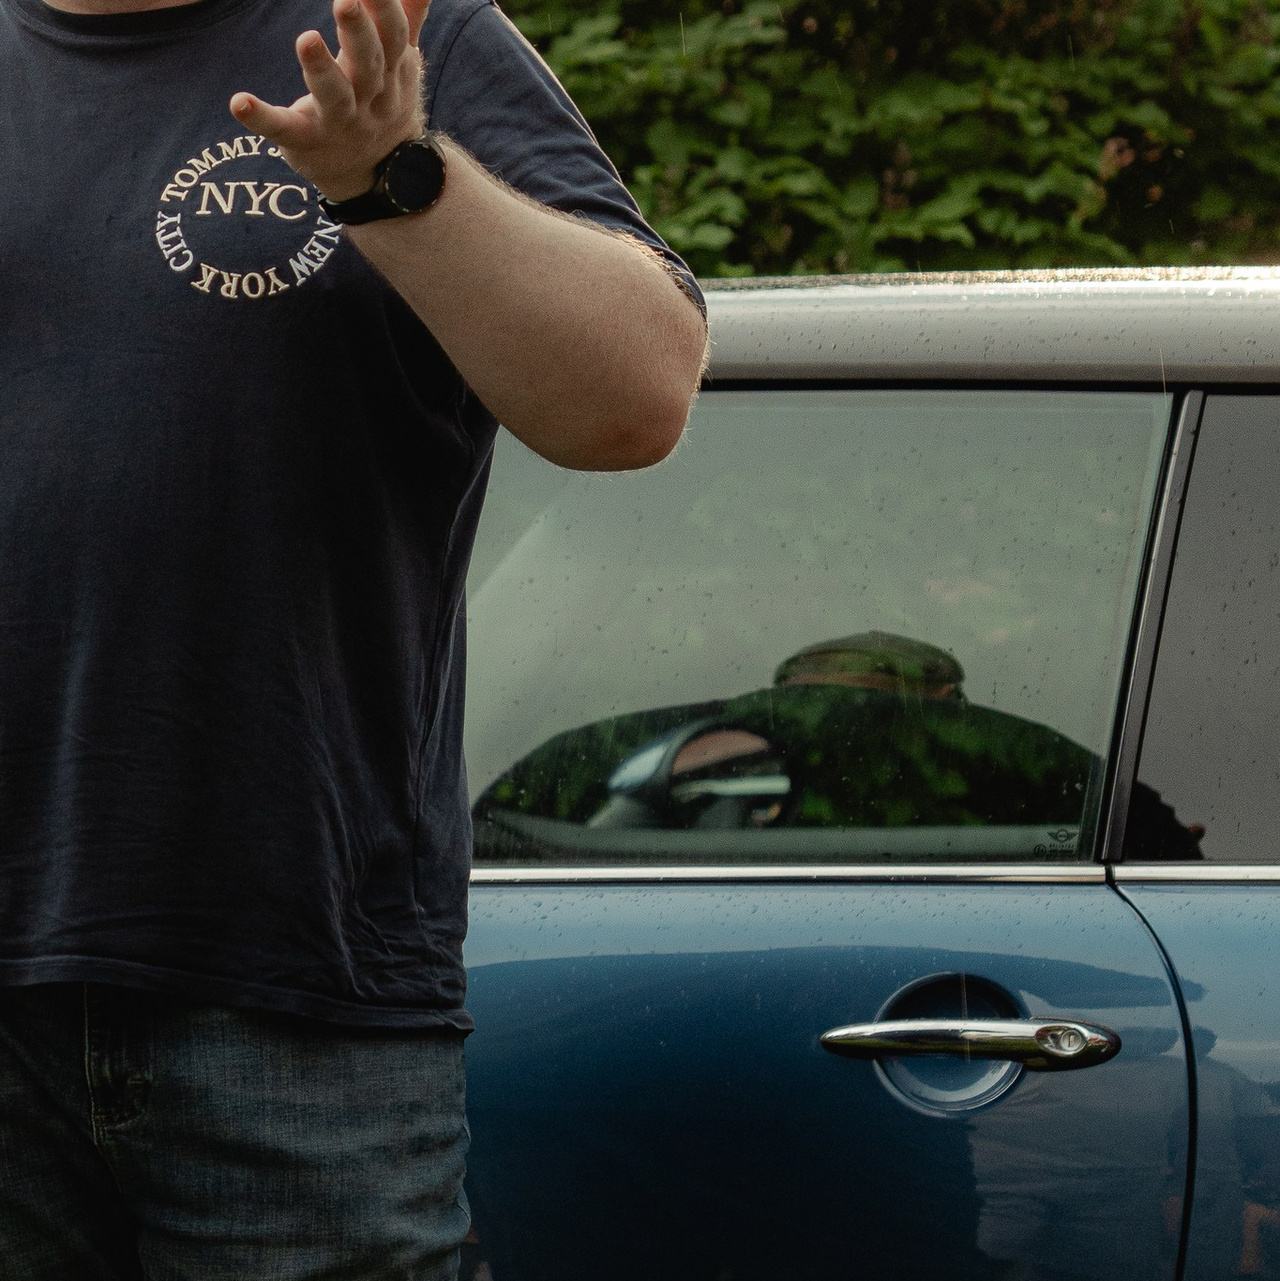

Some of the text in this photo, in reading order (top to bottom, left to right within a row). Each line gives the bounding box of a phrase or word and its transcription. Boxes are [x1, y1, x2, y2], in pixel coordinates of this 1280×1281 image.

[160, 135, 265, 203] TOMMY
[195, 181, 308, 221] NYC
[155, 210, 343, 299] NEW YORK CITY
